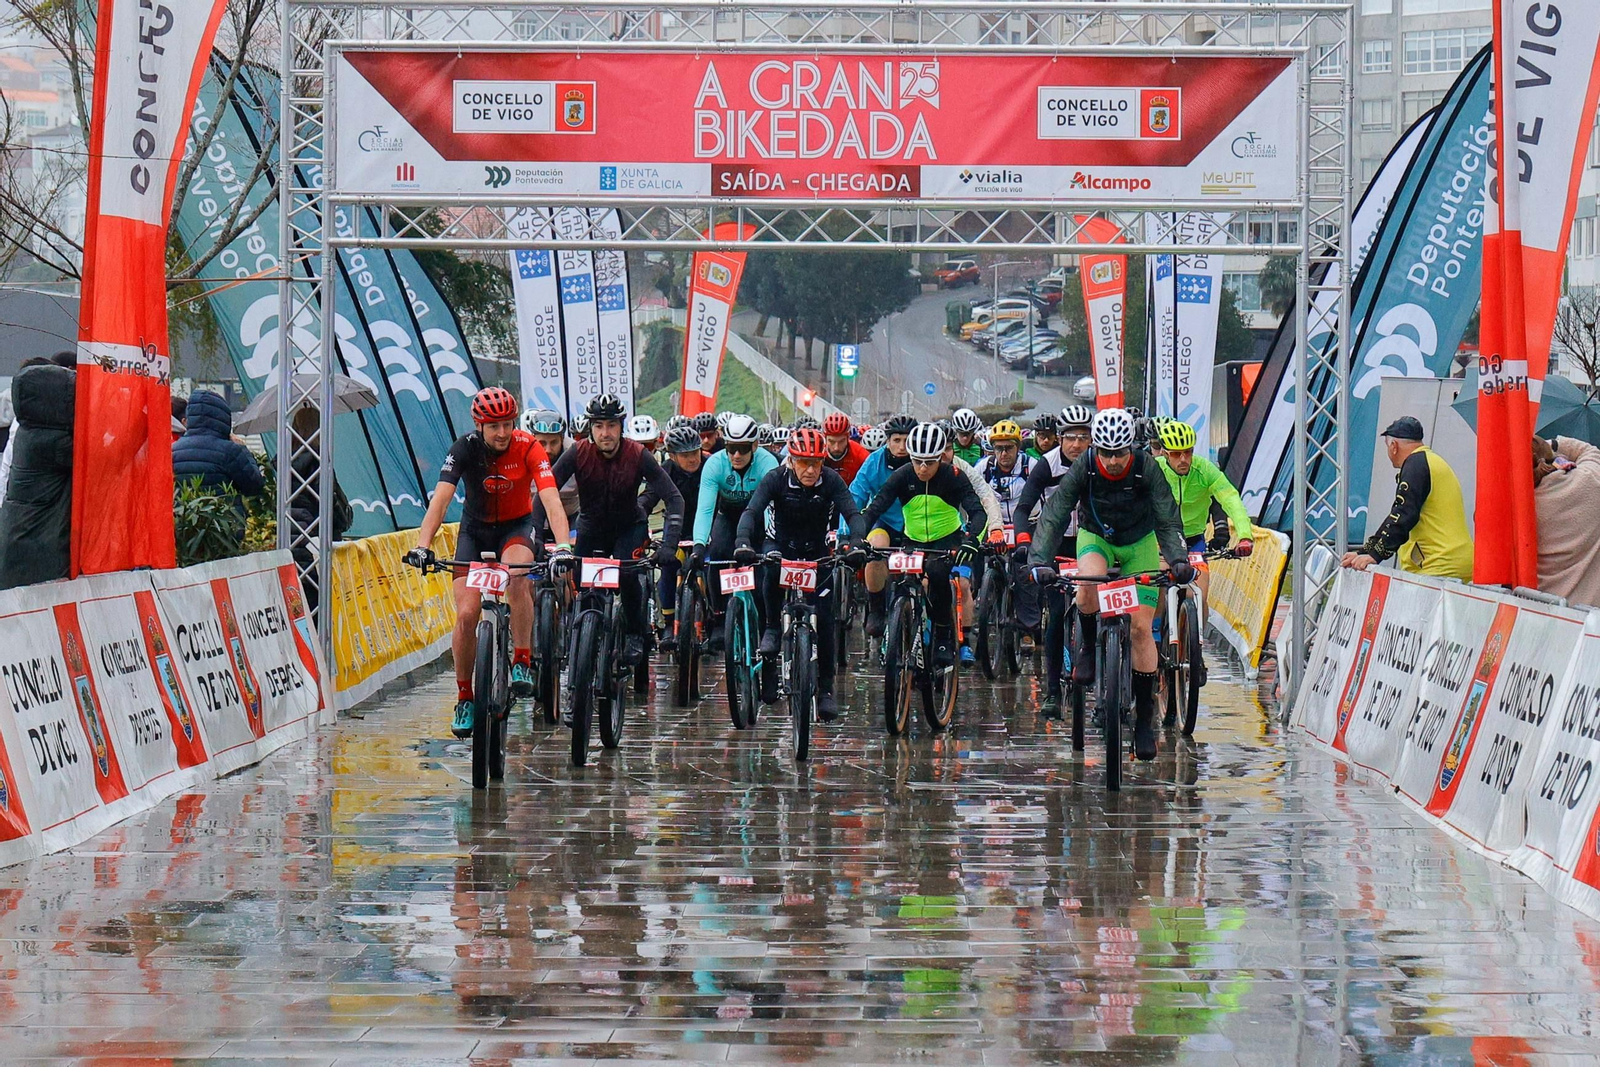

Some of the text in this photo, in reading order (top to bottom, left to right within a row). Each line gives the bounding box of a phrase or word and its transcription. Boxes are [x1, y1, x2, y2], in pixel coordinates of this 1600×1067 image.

[1515, 2, 1562, 89] VIG
[693, 60, 893, 110] A GRAN
[901, 64, 940, 99] 25
[462, 92, 543, 105] CONCELLO
[1047, 99, 1128, 112] CONCELLO
[472, 108, 534, 121] DE VIGO
[1056, 114, 1119, 127] DE VIGO
[694, 110, 938, 160] BIKEDADA
[515, 168, 563, 177] Deputación
[621, 168, 659, 178] XUNTA
[976, 170, 1023, 183] vialia
[1202, 172, 1255, 183] MeUFIT
[515, 177, 563, 185] Pontevedra
[620, 179, 683, 189] DE GALICIA
[720, 169, 785, 191] SAÍDA
[806, 173, 911, 192] CHEGADA
[1070, 171, 1151, 192] Alcampo
[702, 315, 718, 353] VIGO
[1179, 336, 1192, 396] GALEGO
[894, 556, 917, 568] 311
[472, 571, 500, 590] 270
[725, 574, 749, 589] 190
[1104, 591, 1133, 610] 163
